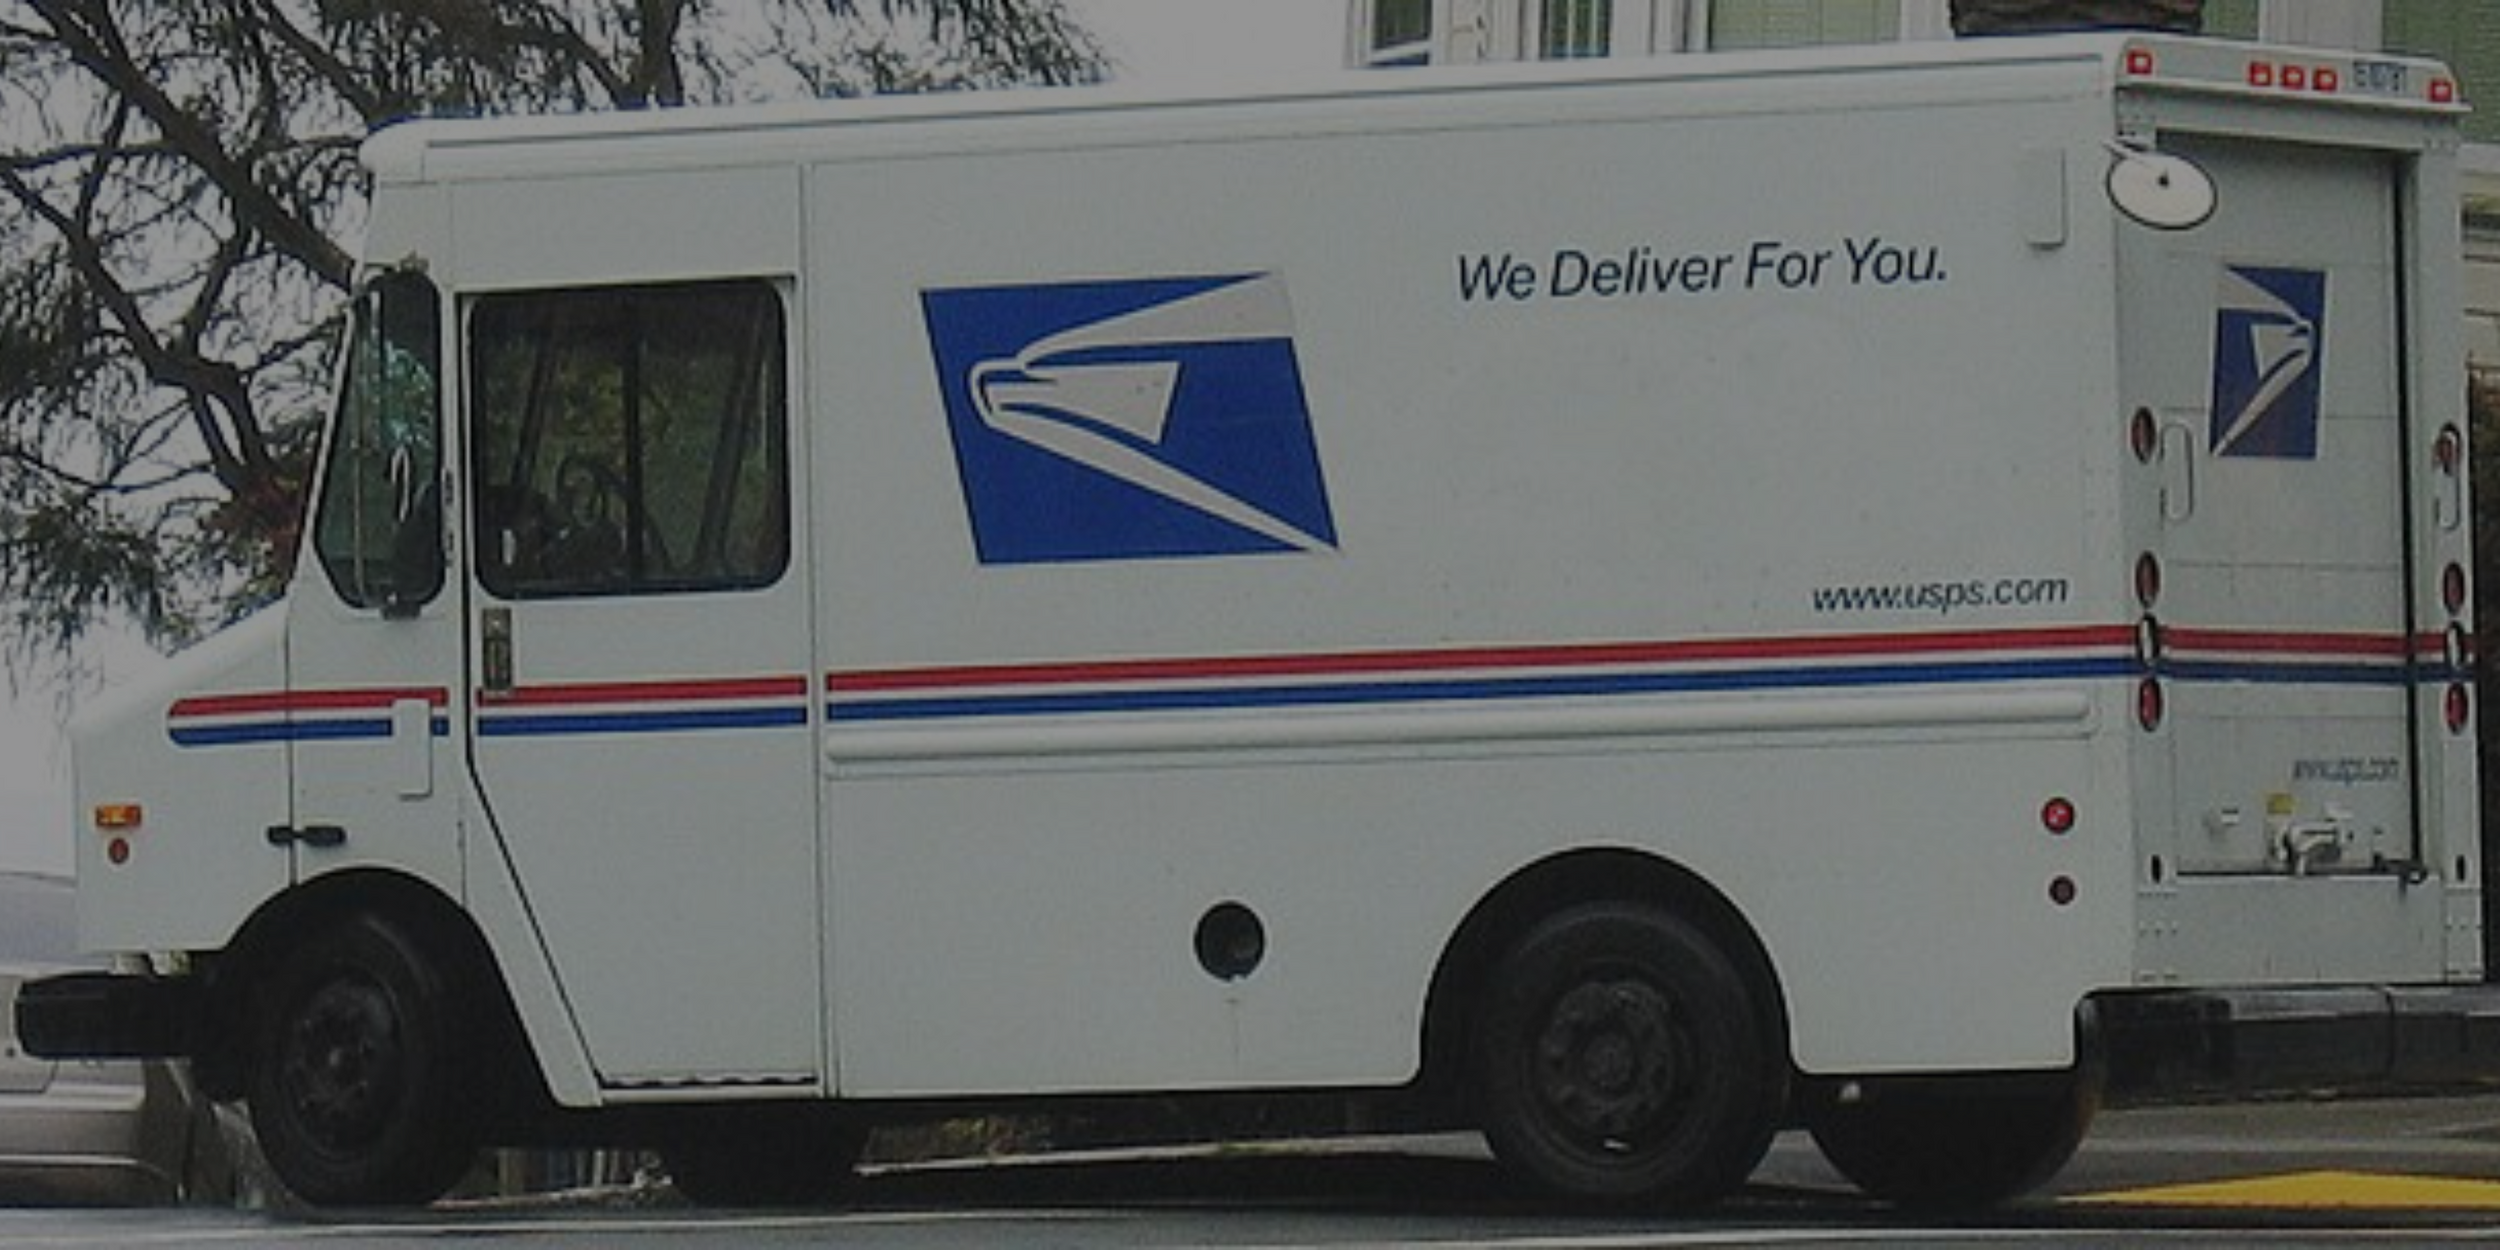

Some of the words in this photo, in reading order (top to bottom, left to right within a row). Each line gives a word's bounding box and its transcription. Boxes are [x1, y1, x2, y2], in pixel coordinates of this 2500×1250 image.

[1457, 252, 1536, 301] We
[1550, 247, 1733, 297] Deliver
[1745, 241, 1833, 289] For
[1844, 236, 1946, 285] You.
[1813, 577, 2069, 615] www.usps.com
